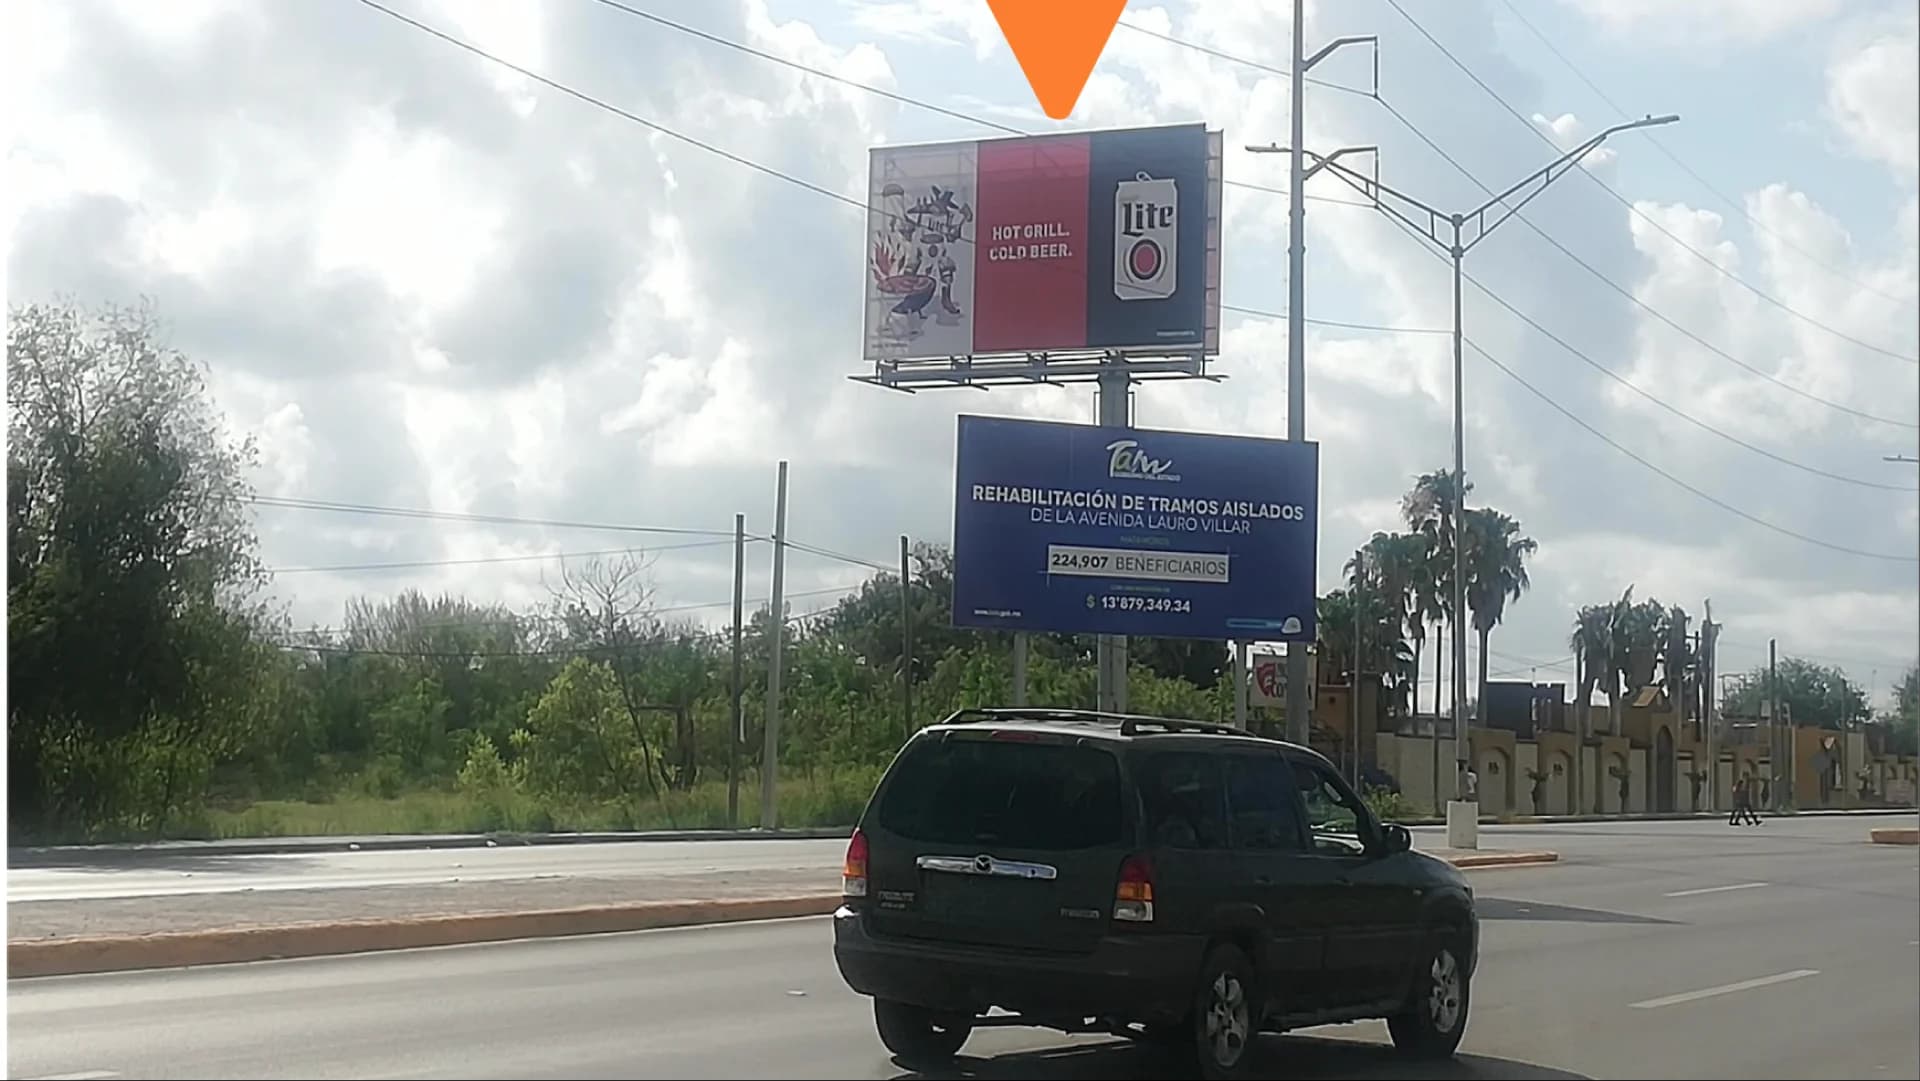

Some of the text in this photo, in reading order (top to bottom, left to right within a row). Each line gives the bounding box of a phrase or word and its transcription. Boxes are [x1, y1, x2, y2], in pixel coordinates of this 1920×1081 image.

[992, 222, 1070, 240] HOT GRILL.
[1122, 202, 1174, 237] Lite
[989, 243, 1073, 260] COLD BEER.
[972, 485, 1304, 521] REHABILITACIÓN DE TRAMOS AISLADOS
[1031, 507, 1250, 534] DE LA AVENIDA LAURO VILLAR
[1052, 553, 1227, 576] 224,907 BENEFICIARIOS
[1086, 594, 1191, 613] $ 13'879,349.34
